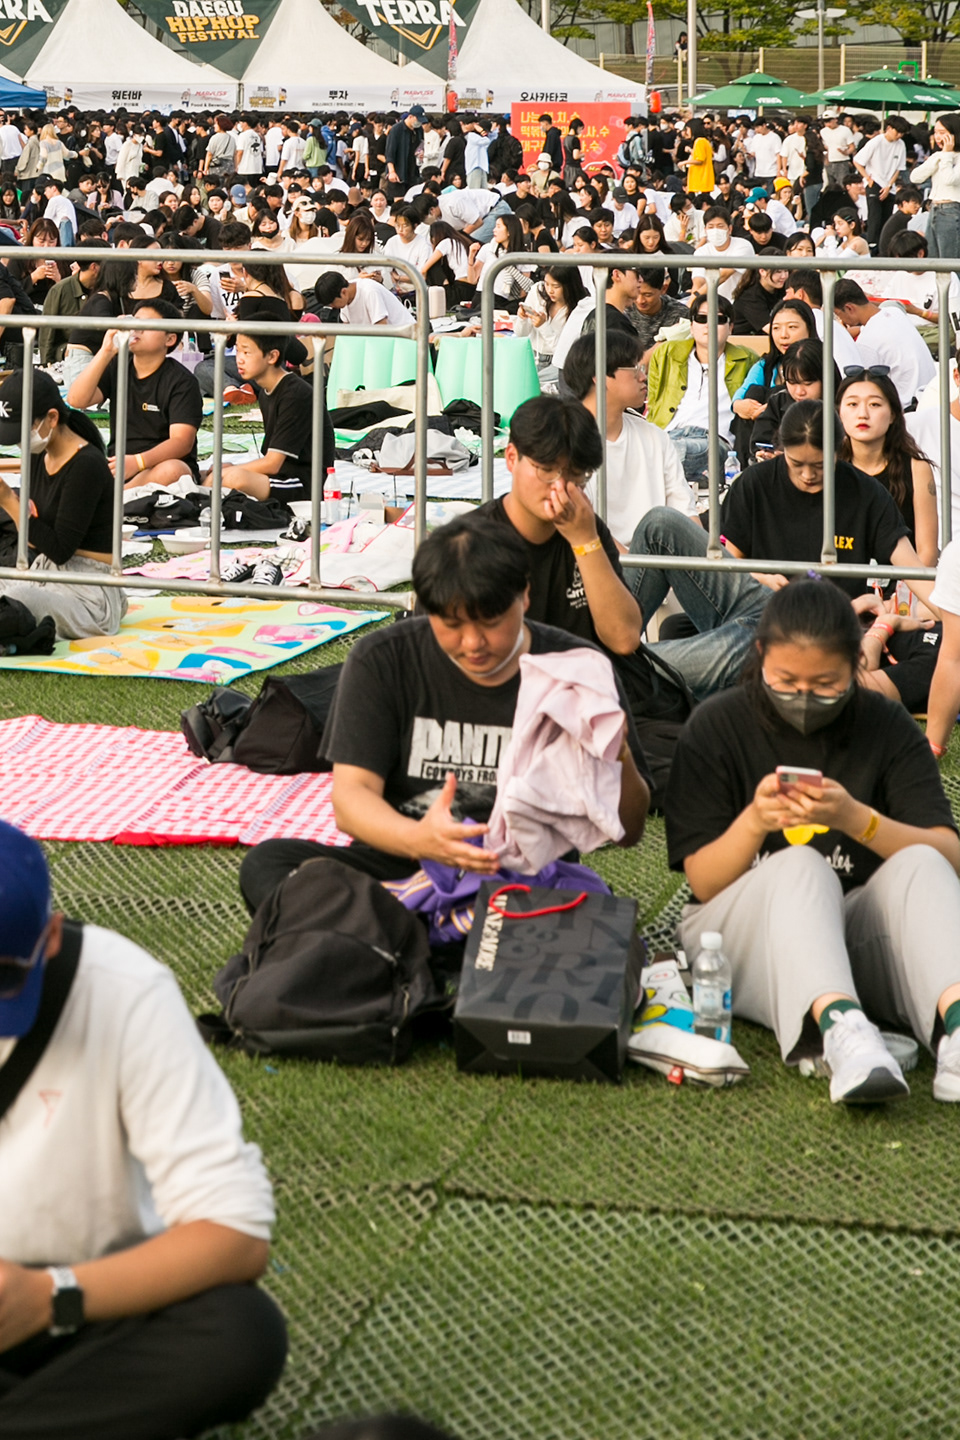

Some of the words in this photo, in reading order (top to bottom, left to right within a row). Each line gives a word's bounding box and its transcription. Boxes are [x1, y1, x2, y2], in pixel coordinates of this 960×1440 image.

[172, 0, 244, 19] DAEGU
[165, 14, 260, 33] HIPHOP
[177, 29, 260, 44] FESTIVAL
[111, 90, 142, 101] 워터바
[520, 91, 568, 102] 오사카타코
[521, 111, 540, 124] 나는
[477, 769, 498, 782] FRO
